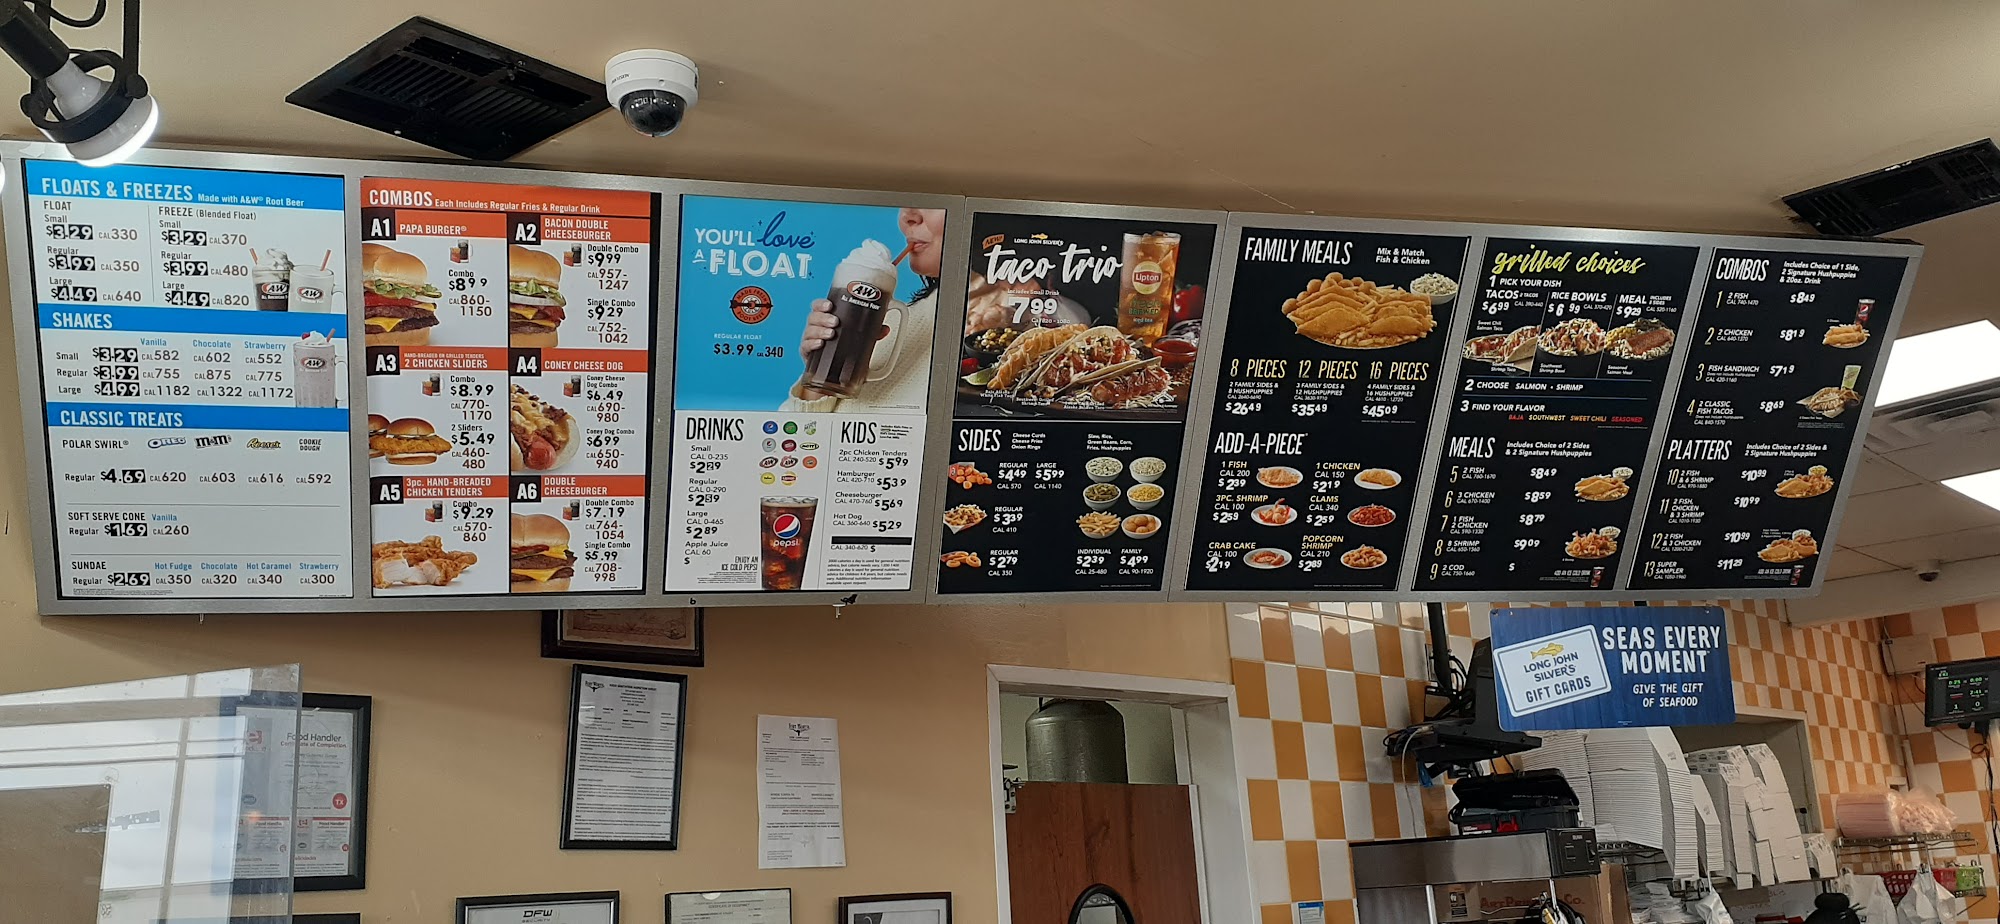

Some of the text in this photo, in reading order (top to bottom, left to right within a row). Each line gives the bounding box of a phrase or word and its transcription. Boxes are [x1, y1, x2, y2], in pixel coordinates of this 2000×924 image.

[42, 178, 304, 207] FLOATS & FREEZES Made with Root Beer
[44, 201, 71, 211] FLOAT
[369, 190, 600, 214] COMBOS Each Includes Regular Fries Regular Drink
[44, 214, 67, 223] Small
[159, 206, 256, 221] FREEZE (Blended Float)
[371, 218, 390, 236] A1
[400, 224, 423, 234] PAPA
[545, 218, 608, 230] BACON DOUBLE
[695, 211, 815, 249] YOU'LL love
[46, 225, 93, 240] $3.29
[516, 224, 536, 241] A2
[545, 230, 611, 240] CHEESEBURGER
[1245, 237, 1352, 265] FAMILY MEALS
[692, 249, 812, 278] A FLOAT
[984, 243, 1123, 285] taco trio
[1401, 257, 1430, 265] Chicken
[1492, 244, 1645, 275] grilled choices
[1716, 258, 1769, 282] COMBOS
[1136, 274, 1160, 282] Lipton
[1500, 278, 1561, 287] PICK YOUR DISH
[1486, 290, 1519, 299] TACOS
[1551, 292, 1607, 302] RICE BOWLS
[1619, 295, 1646, 304] MEAL
[52, 312, 112, 329] SHAKES
[141, 338, 286, 351] Vanilla Chocolate Strawberry
[714, 344, 753, 355] $3.99
[412, 359, 488, 368] CHICKEN SLIDERS
[544, 361, 623, 370] CONEY CHEESE DOG
[1230, 359, 1287, 378] 8 PIECES
[1298, 360, 1358, 379] 12 PIECES
[1370, 361, 1429, 380] 16 PIECES
[1724, 365, 1760, 373] SANDWICH
[450, 385, 494, 397] $8.99
[1477, 381, 1509, 389] CHOOSE
[1556, 383, 1583, 391] SHRIMP
[61, 411, 183, 427] CLASSIC TREATS
[686, 417, 744, 441] DRINKS
[841, 421, 877, 444] KIDS
[62, 437, 186, 449] POLAR OREO
[958, 429, 1001, 451] SIDES
[1449, 437, 1496, 458] MEALS
[1519, 449, 1592, 457] Signature Hushpuppies
[1668, 440, 1732, 460] PLATTERS
[65, 469, 145, 484] Regular $4.69
[427, 477, 491, 486] HAND-BREADED
[406, 486, 482, 496] CHICKEN TENDERS
[68, 512, 145, 521] SOFT SERVE CONE
[72, 561, 106, 570] SUNDAE
[1603, 626, 1720, 650] SEAS EVERY
[1524, 652, 1579, 673] LONG JOHN
[1534, 665, 1576, 682] SILVER'S
[1526, 676, 1591, 703] GIFT CARDS
[1633, 683, 1703, 694] GIVE THE GIFT
[1643, 697, 1698, 707] OF SEAFOOD
[311, 733, 341, 741] Handler
